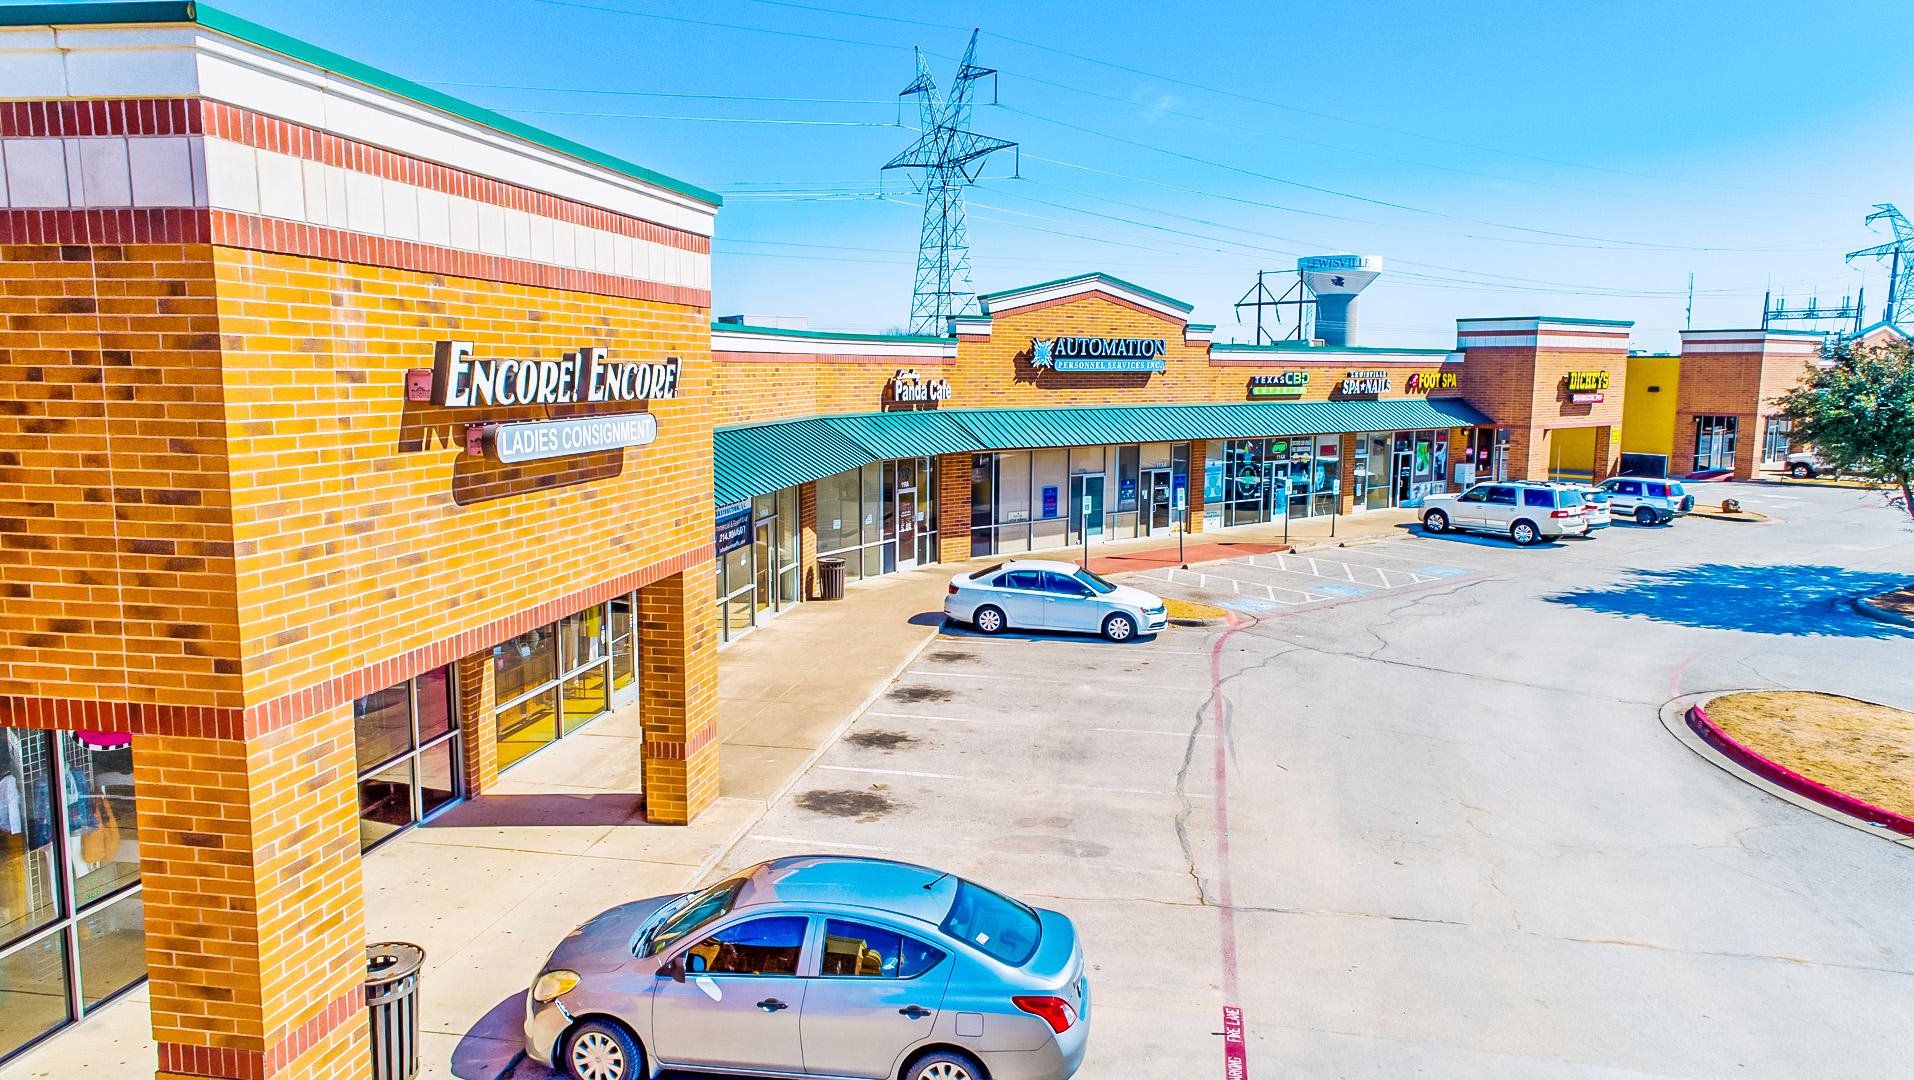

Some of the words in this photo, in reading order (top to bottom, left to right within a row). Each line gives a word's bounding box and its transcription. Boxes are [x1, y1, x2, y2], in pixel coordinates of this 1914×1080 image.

[1054, 338, 1167, 356] AUTOMATION
[445, 341, 582, 407] ENCORE!
[588, 347, 683, 401] ENCORE!
[1057, 361, 1105, 369] PERSONNEL
[1107, 361, 1145, 369] SERVICES
[1254, 376, 1285, 384] TEXAS
[1285, 372, 1310, 384] CBD
[1342, 379, 1360, 394] SPA
[1364, 379, 1392, 394] NAILS
[1418, 373, 1441, 388] FOOT
[1441, 373, 1457, 388] SPA
[1569, 371, 1609, 390] DICKEY'S
[896, 379, 927, 401] Panda
[930, 379, 952, 401] Cafe
[502, 427, 558, 456] LADIES
[562, 419, 652, 447] CONSIGNMENT
[1225, 1007, 1240, 1026] LANE
[1226, 1027, 1243, 1043] FIRE
[1227, 1056, 1243, 1080] ARKING
